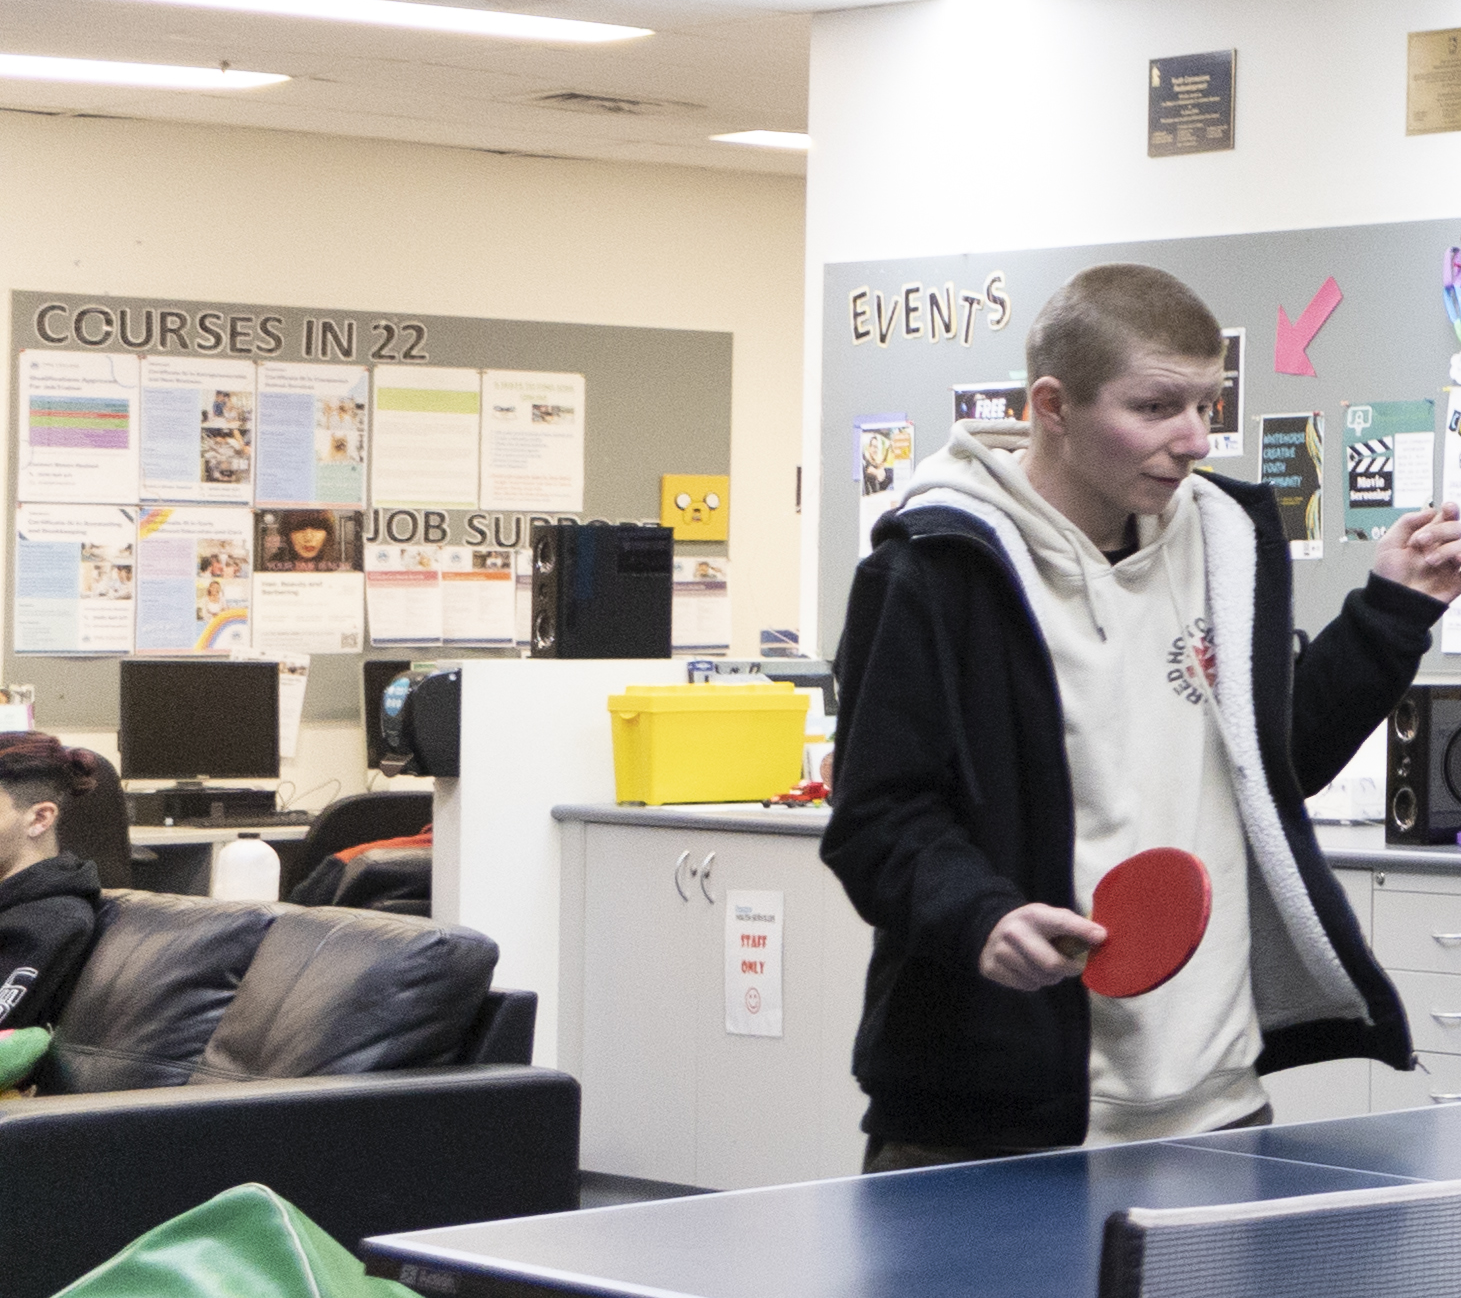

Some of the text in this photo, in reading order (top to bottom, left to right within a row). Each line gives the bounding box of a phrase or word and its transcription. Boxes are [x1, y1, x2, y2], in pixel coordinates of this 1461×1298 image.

[850, 273, 1010, 346] EVENTS
[36, 303, 428, 361] COURSES IN 22
[975, 397, 1007, 420] FREE
[1356, 474, 1385, 488] Movie
[366, 510, 448, 544] JOB
[740, 934, 767, 948] STAFF
[741, 960, 765, 974] ONLY
